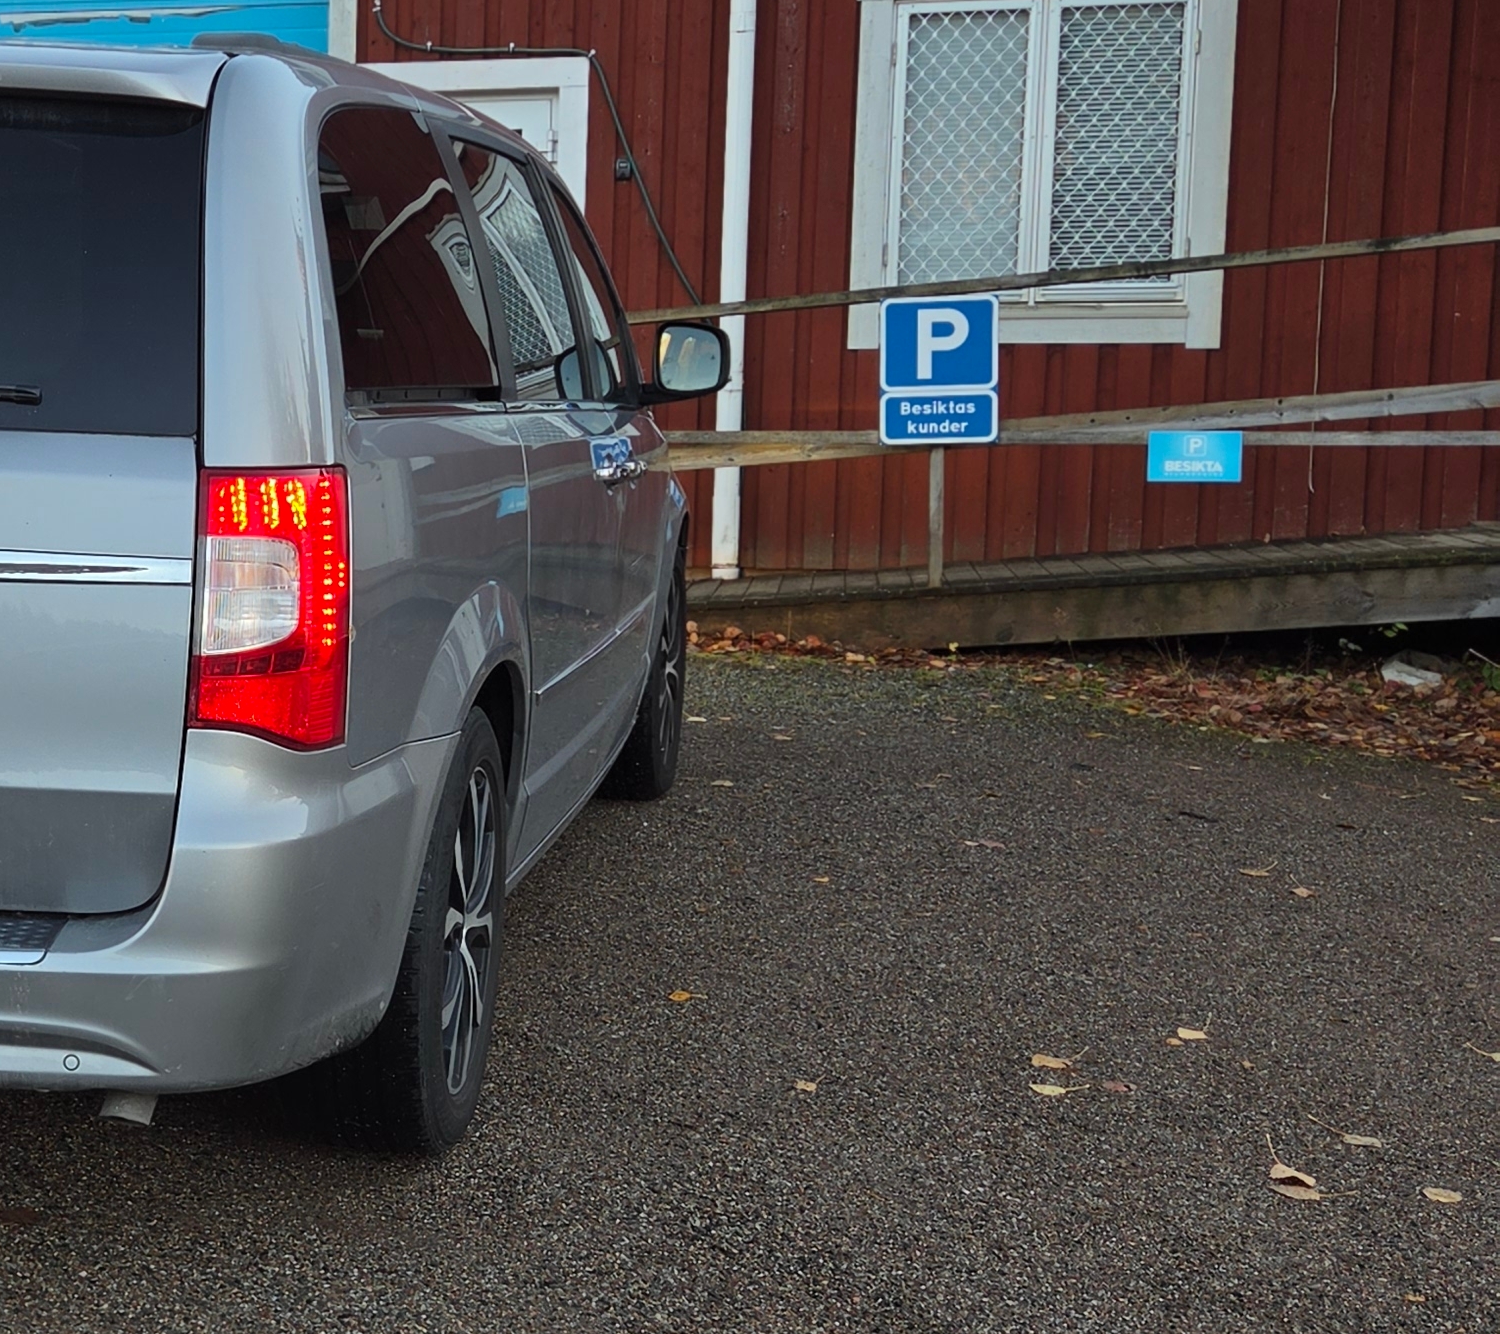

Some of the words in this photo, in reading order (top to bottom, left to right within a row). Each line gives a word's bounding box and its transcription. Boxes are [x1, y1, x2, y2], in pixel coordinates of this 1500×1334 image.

[917, 308, 970, 380] P
[900, 400, 976, 416] Besiktas
[907, 419, 969, 434] kunder
[1189, 438, 1202, 454] P
[1164, 460, 1223, 473] BESIKTA
